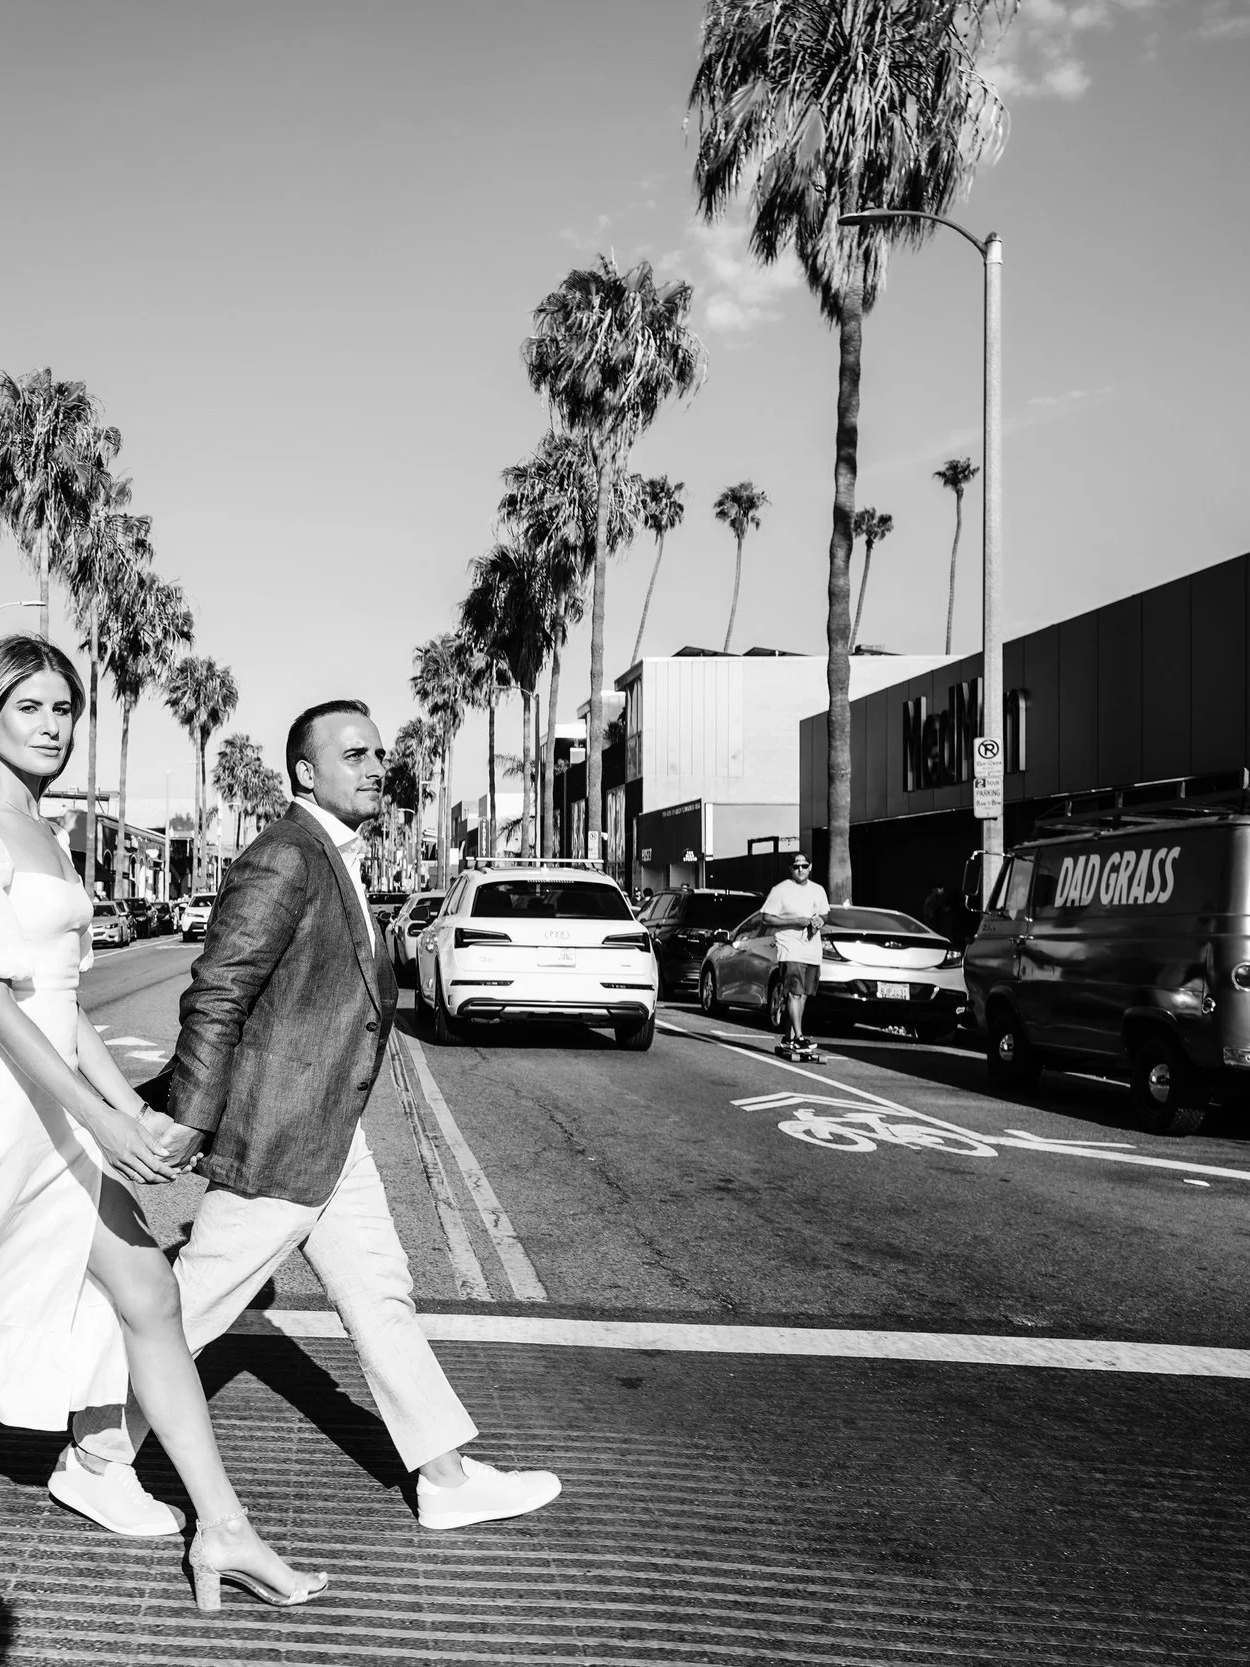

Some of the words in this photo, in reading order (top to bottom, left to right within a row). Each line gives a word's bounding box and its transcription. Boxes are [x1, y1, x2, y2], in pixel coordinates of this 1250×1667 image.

[902, 677, 1028, 792] MedMn
[976, 789, 1001, 798] PARKING
[1054, 853, 1100, 908] DAD
[1100, 847, 1181, 906] GRASS
